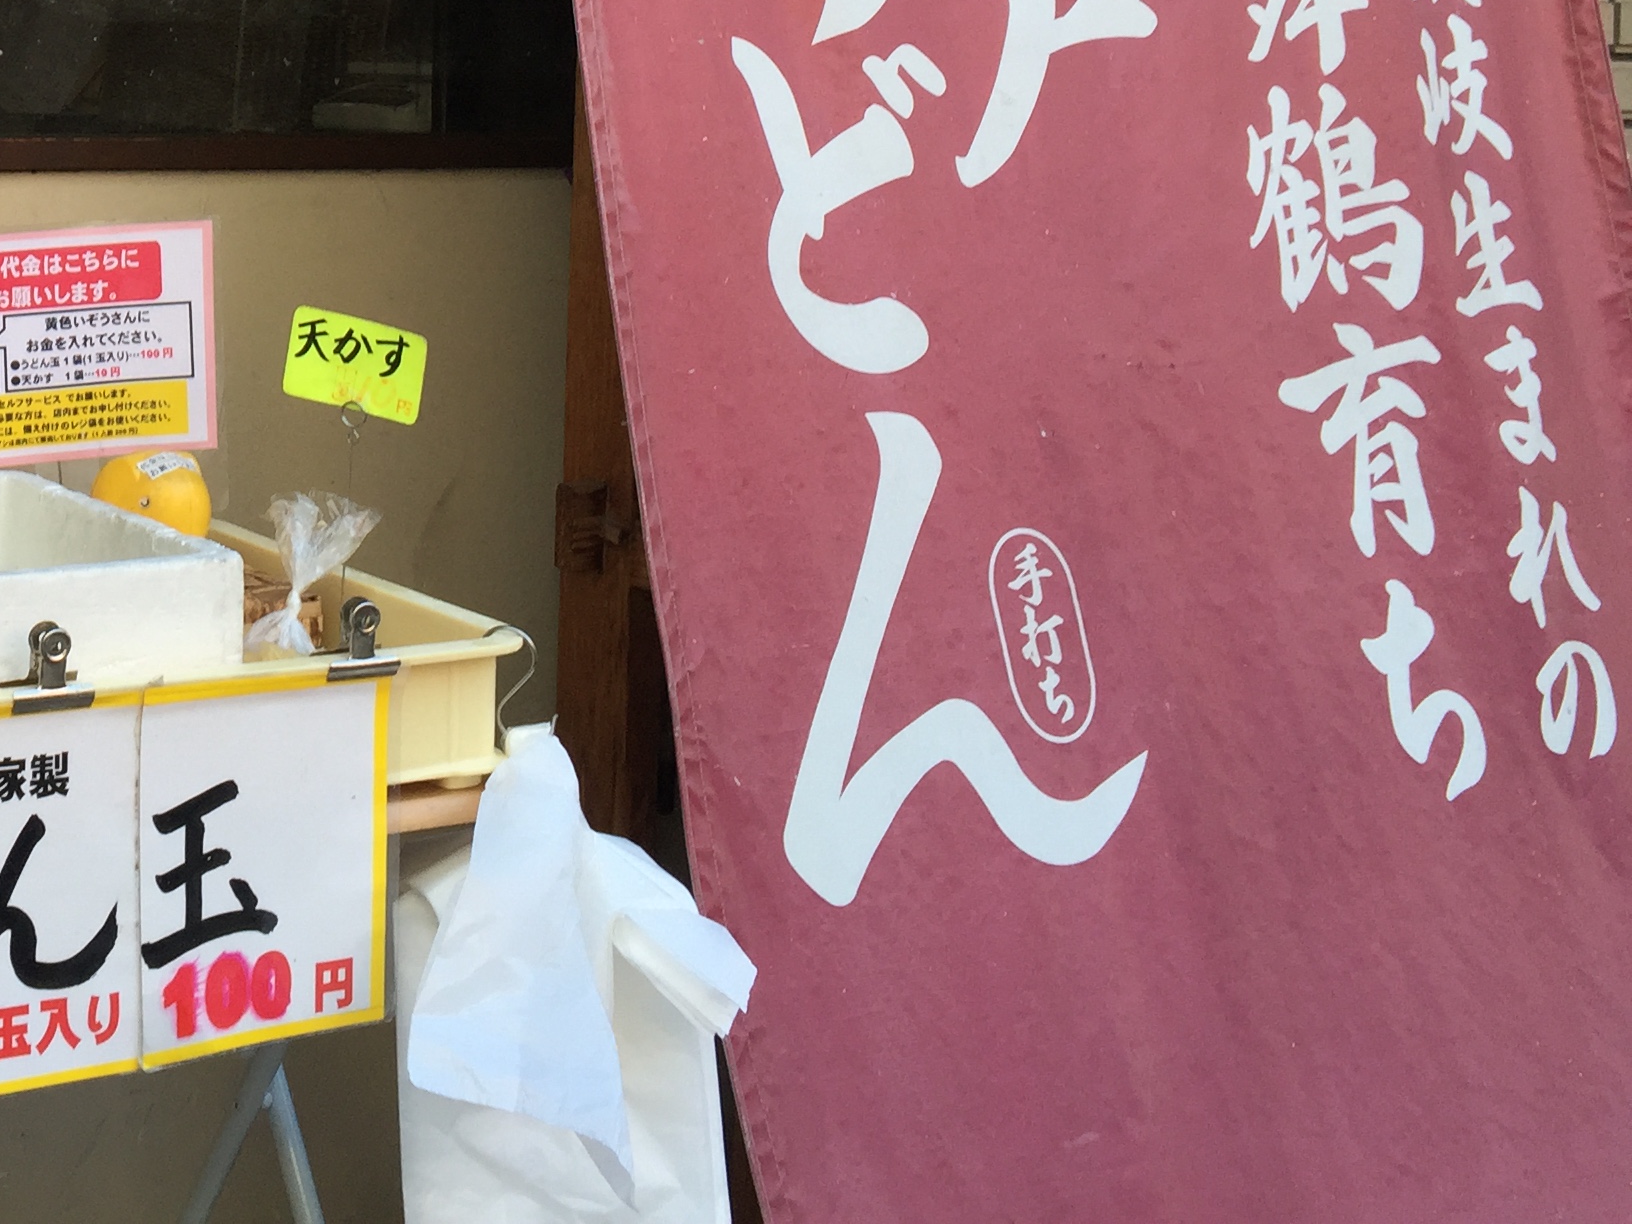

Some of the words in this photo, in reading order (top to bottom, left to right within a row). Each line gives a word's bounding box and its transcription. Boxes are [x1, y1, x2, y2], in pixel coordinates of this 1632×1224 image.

[25, 329, 163, 353] お金を入れてください。
[44, 310, 151, 332] 黄色いぞうさんに
[294, 318, 411, 378] 天かす
[1007, 543, 1075, 725] 手打ち
